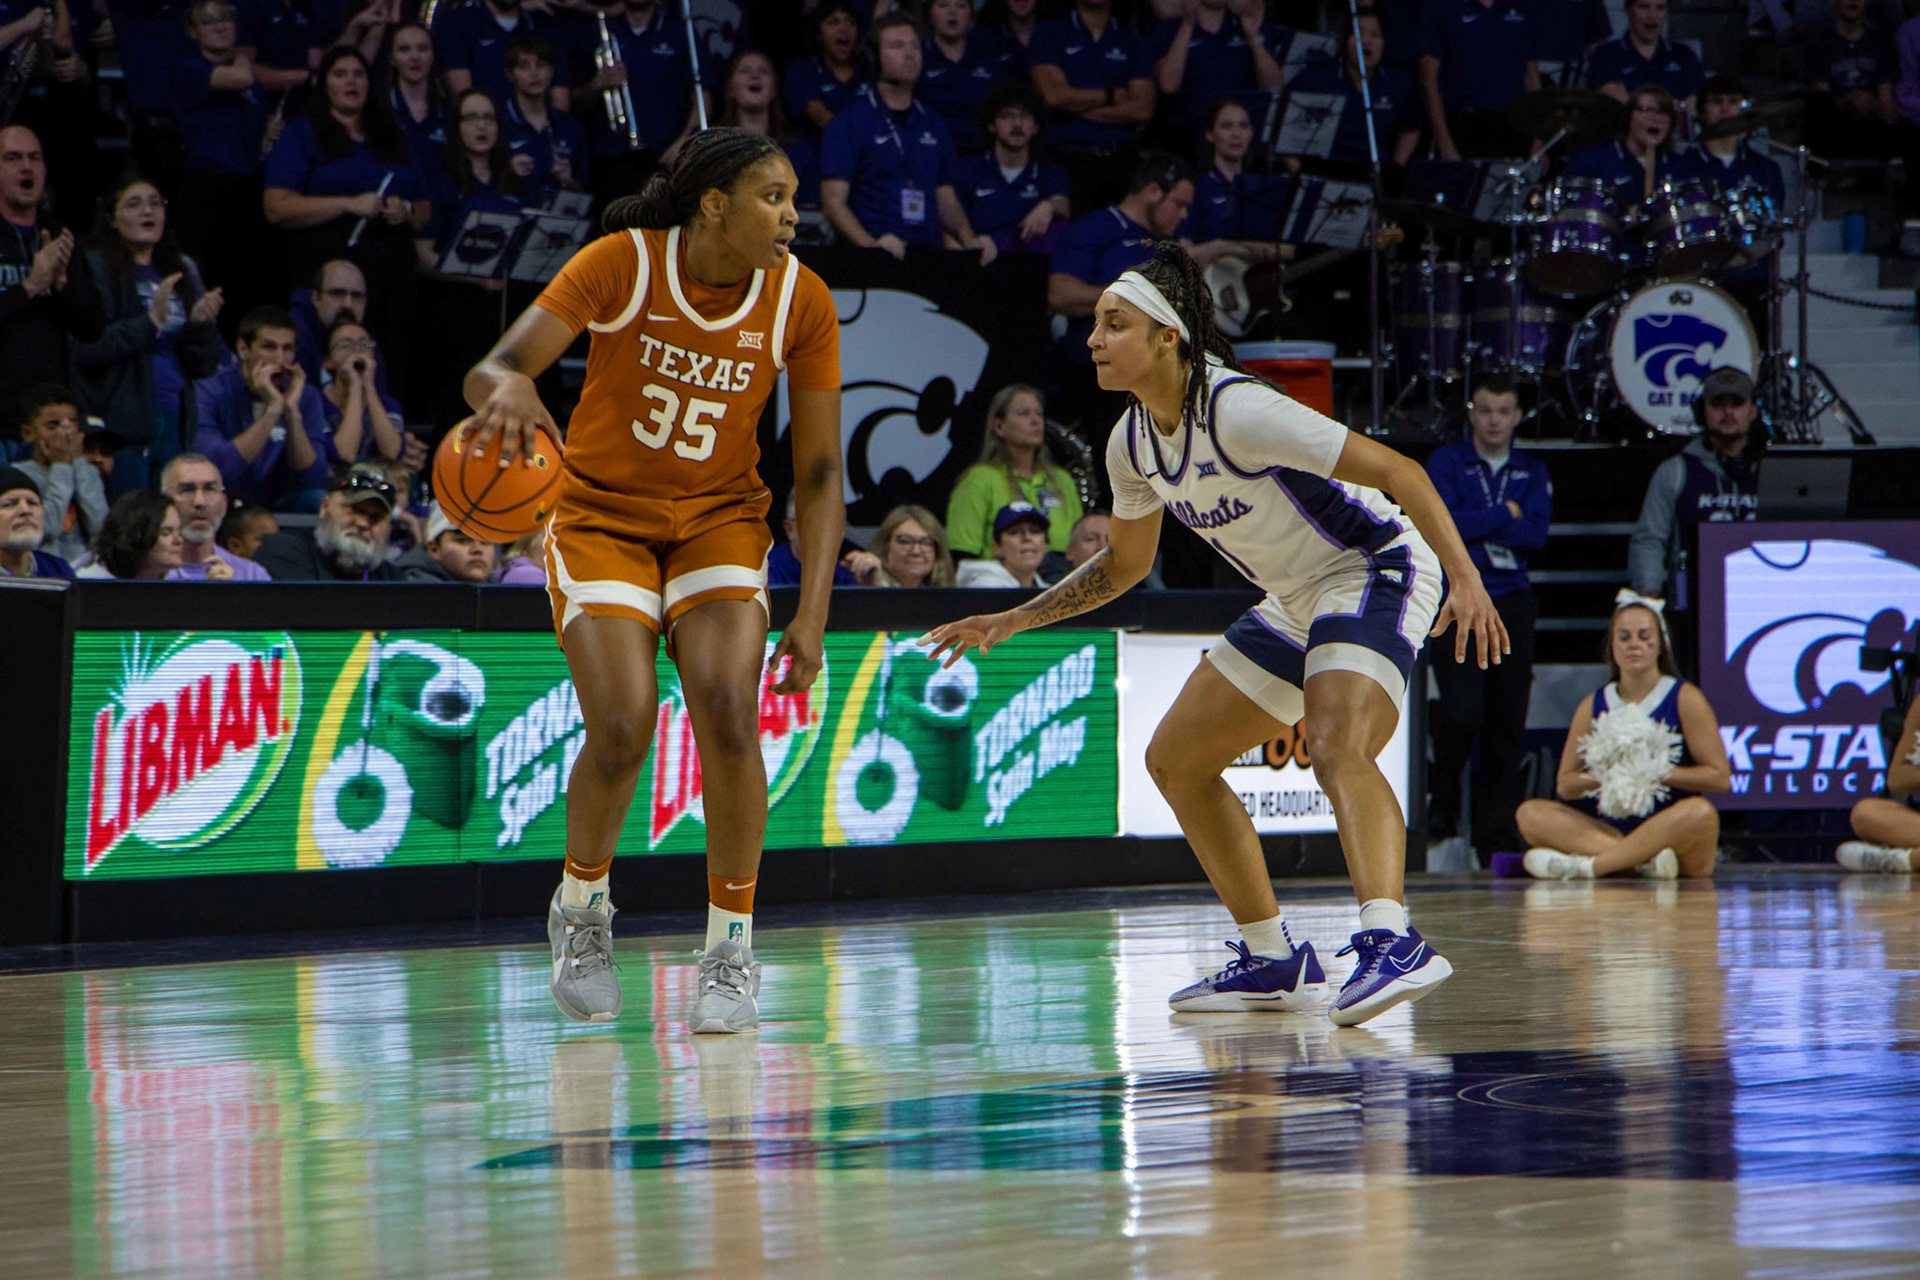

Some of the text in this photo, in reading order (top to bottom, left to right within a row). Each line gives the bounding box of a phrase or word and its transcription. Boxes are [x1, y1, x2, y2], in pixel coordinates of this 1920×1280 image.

[639, 333, 756, 392] TEXAS
[631, 383, 728, 462] 35
[1648, 392, 1674, 407] CAT
[1167, 493, 1254, 530] ldcats
[485, 678, 585, 799] TORNA
[975, 644, 1097, 784] TORNADO
[1719, 725, 1888, 771] K-STA
[86, 654, 283, 868] LIBMAN
[984, 716, 1088, 827] Spin Mop
[1729, 771, 1887, 794] WILDCA
[497, 763, 558, 847] Spin
[1260, 790, 1334, 819] HEADQUART
